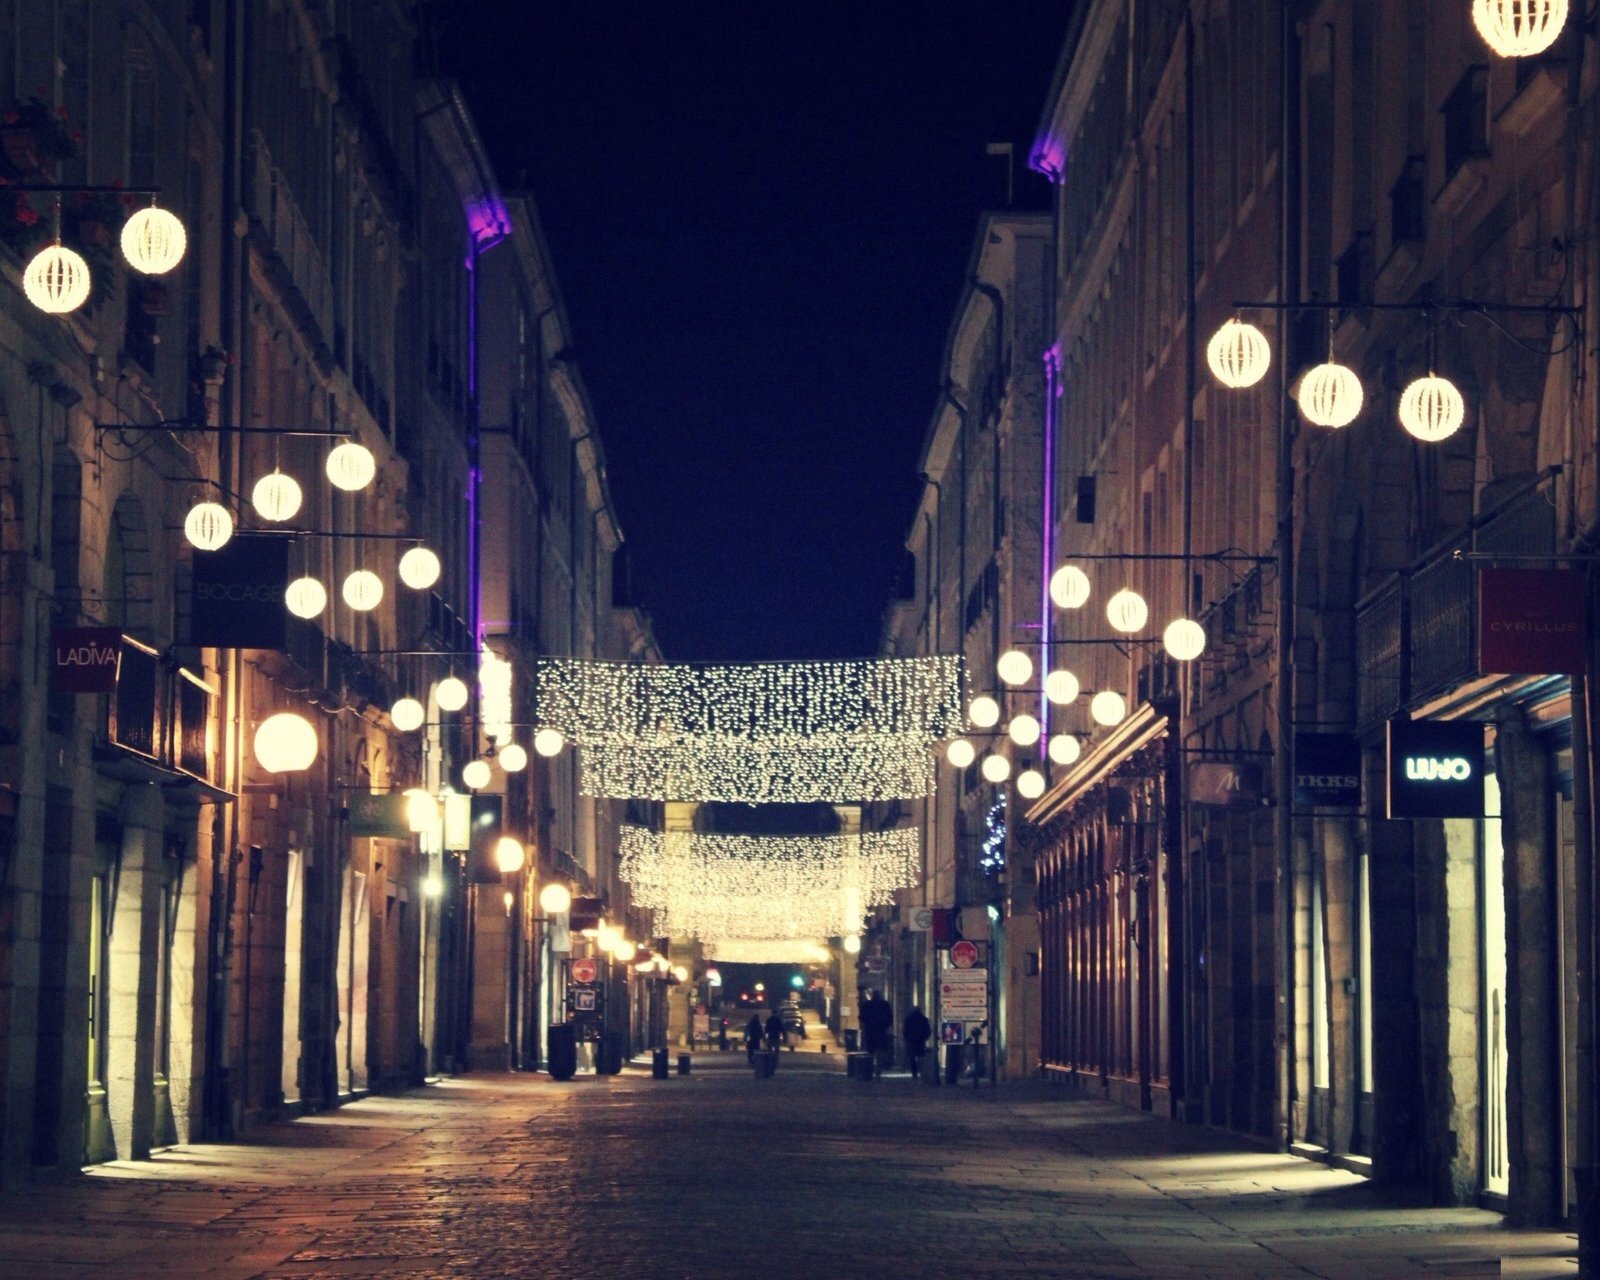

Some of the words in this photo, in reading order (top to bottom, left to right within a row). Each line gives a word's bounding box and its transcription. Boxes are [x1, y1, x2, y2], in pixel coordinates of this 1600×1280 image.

[197, 583, 282, 601] BOCAGE
[1490, 621, 1578, 632] CYRILLUS
[56, 641, 118, 666] LADIVA
[1296, 775, 1360, 788] IKKS
